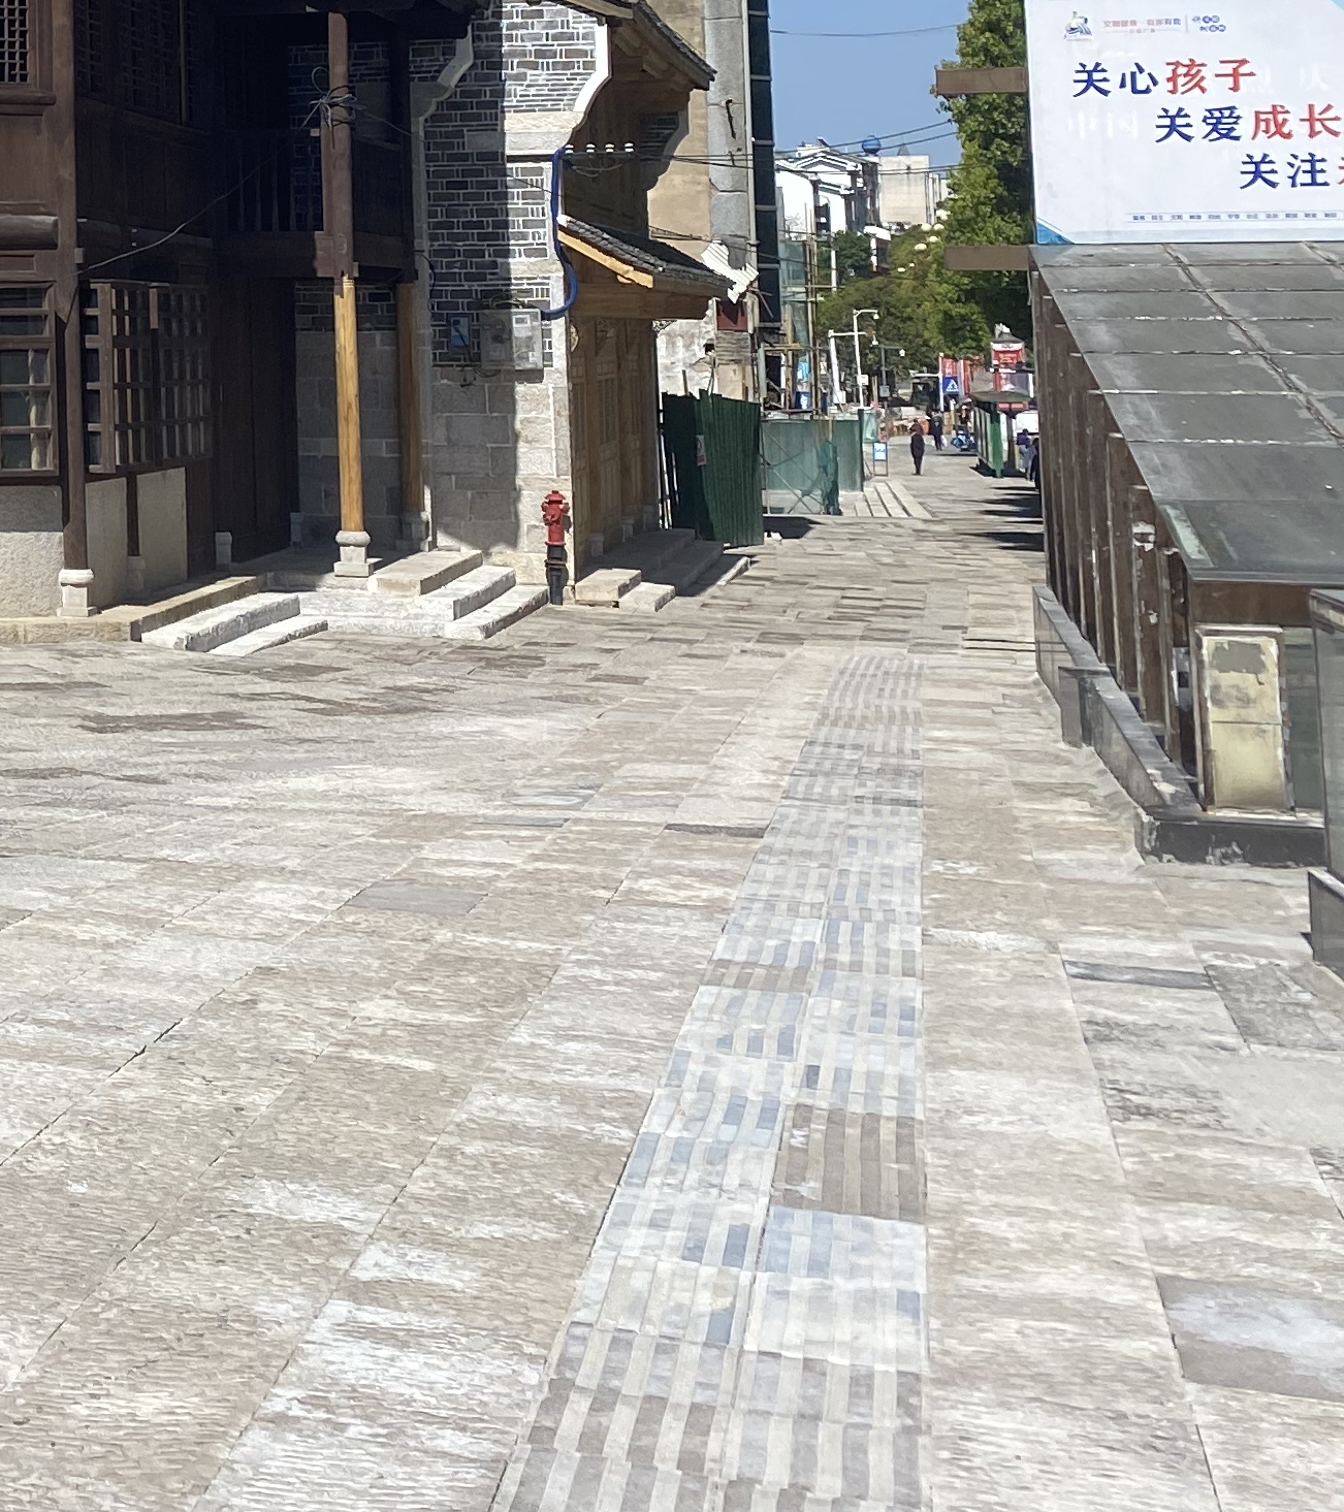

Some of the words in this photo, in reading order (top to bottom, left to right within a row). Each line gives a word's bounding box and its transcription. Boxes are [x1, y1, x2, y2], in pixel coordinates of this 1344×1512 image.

[1072, 58, 1256, 97] 关心孩子
[1155, 103, 1342, 143] 关爱成长
[1240, 152, 1344, 189] 关注
